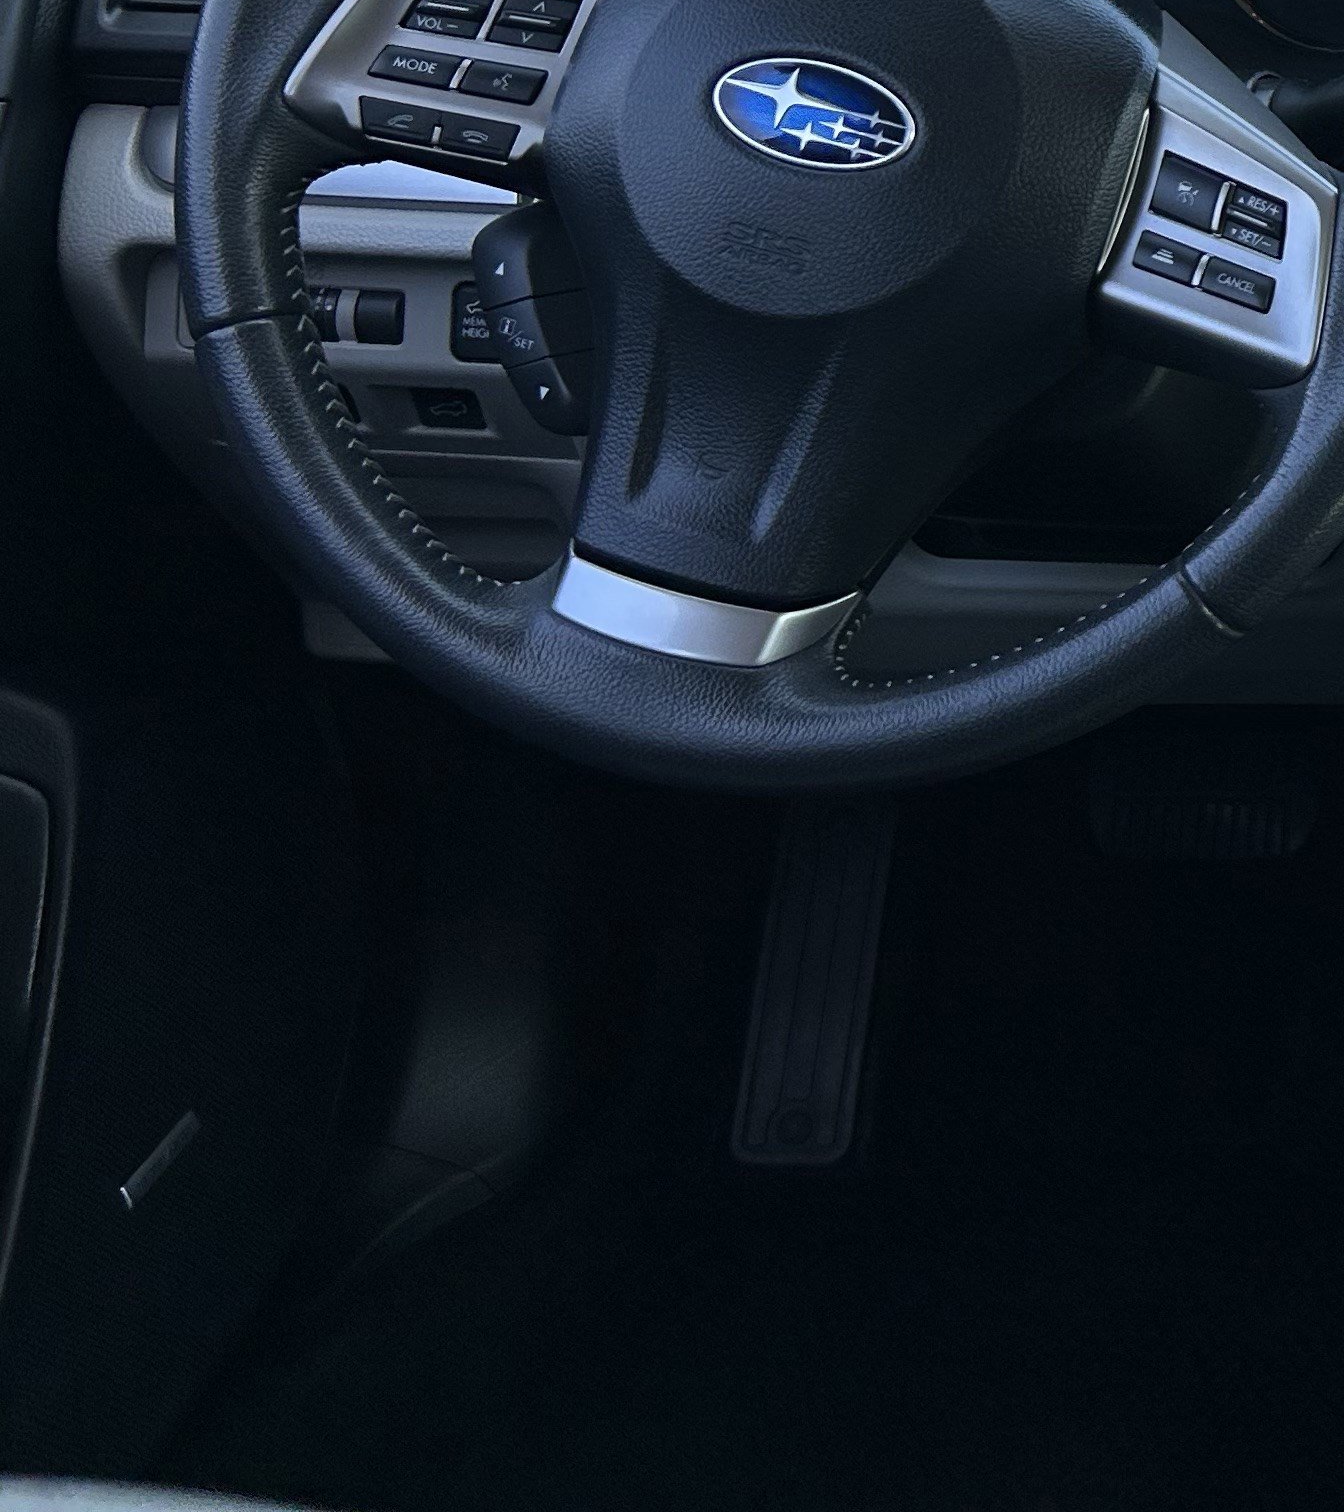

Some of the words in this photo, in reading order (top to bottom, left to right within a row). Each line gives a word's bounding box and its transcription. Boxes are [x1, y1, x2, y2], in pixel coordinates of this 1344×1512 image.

[416, 15, 443, 31] VOL
[392, 55, 438, 75] MODE
[1217, 273, 1256, 295] CANCEL
